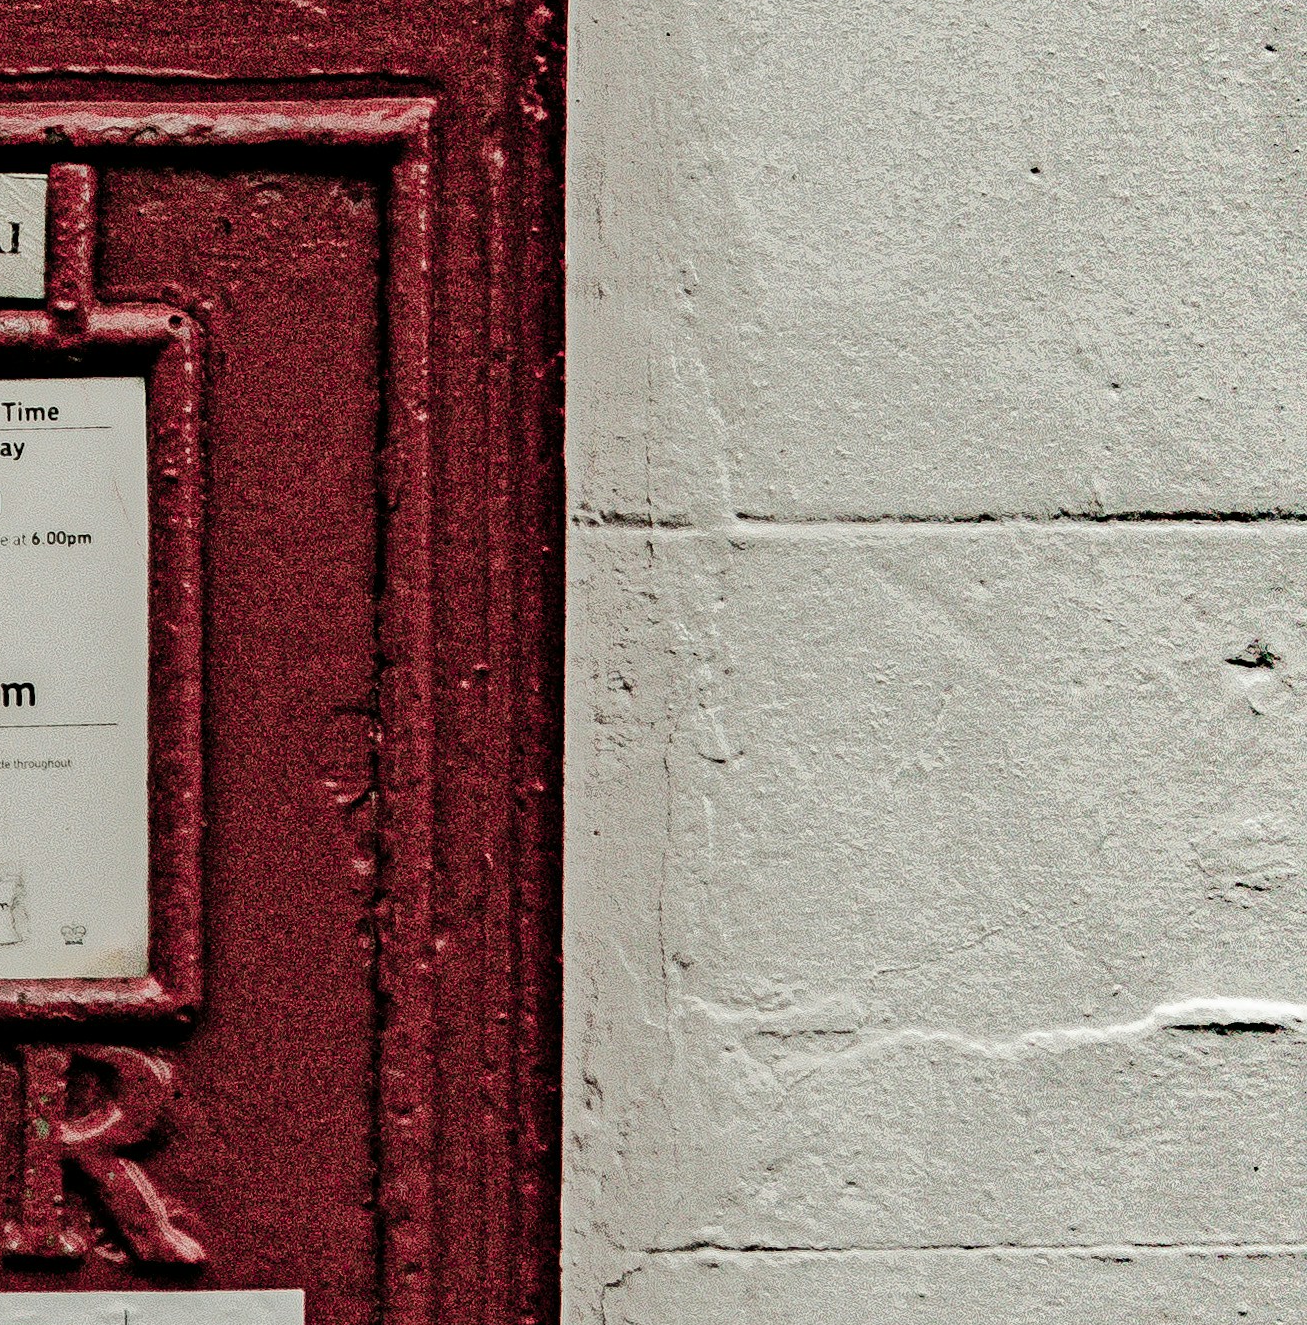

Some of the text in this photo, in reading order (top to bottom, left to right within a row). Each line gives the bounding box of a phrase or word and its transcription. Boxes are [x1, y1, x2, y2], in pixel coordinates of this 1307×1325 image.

[1, 402, 60, 422] Time
[13, 534, 27, 546] at
[31, 531, 92, 548] 6.00pm
[13, 758, 73, 771] throughout
